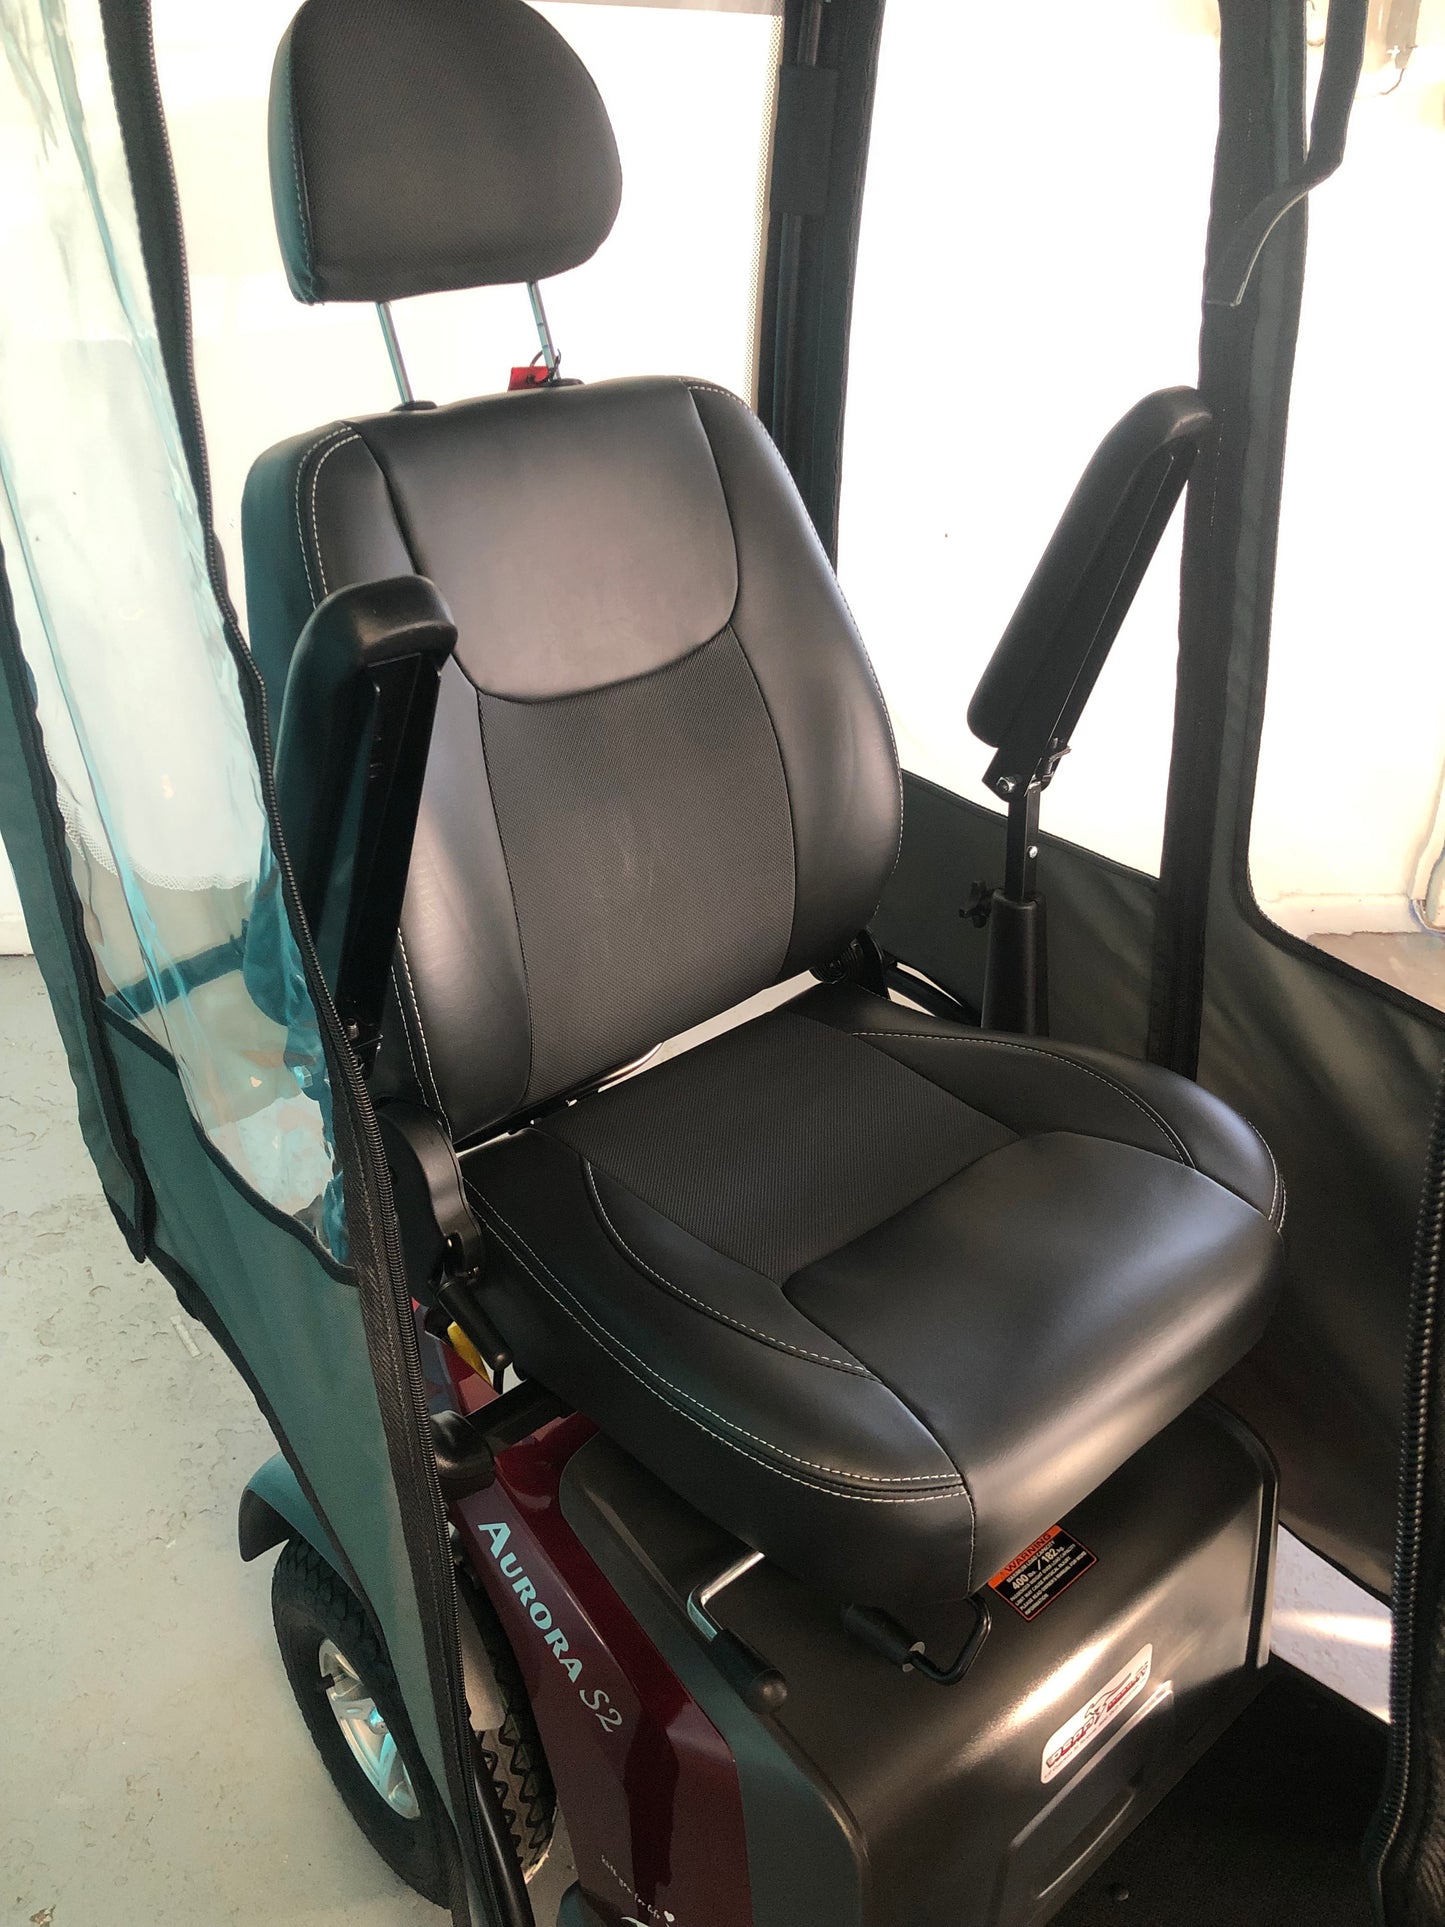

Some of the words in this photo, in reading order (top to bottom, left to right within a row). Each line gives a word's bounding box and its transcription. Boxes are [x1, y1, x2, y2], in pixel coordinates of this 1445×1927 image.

[1004, 1532, 1051, 1572] WARNING
[1012, 1574, 1029, 1590] 400
[1041, 1548, 1058, 1563] 182
[1025, 1555, 1038, 1566] LOAD
[1035, 1540, 1055, 1557] CAPACITY
[1019, 1597, 1033, 1610] PLEASE
[1031, 1589, 1042, 1599] READ
[1054, 1564, 1071, 1578] MANUAL
[1068, 1558, 1077, 1566] FOR
[1075, 1550, 1087, 1561] MORE
[477, 1522, 583, 1683] AURORA
[579, 1688, 623, 1733] S2
[634, 1892, 647, 1906] for
[647, 1904, 661, 1919] life
